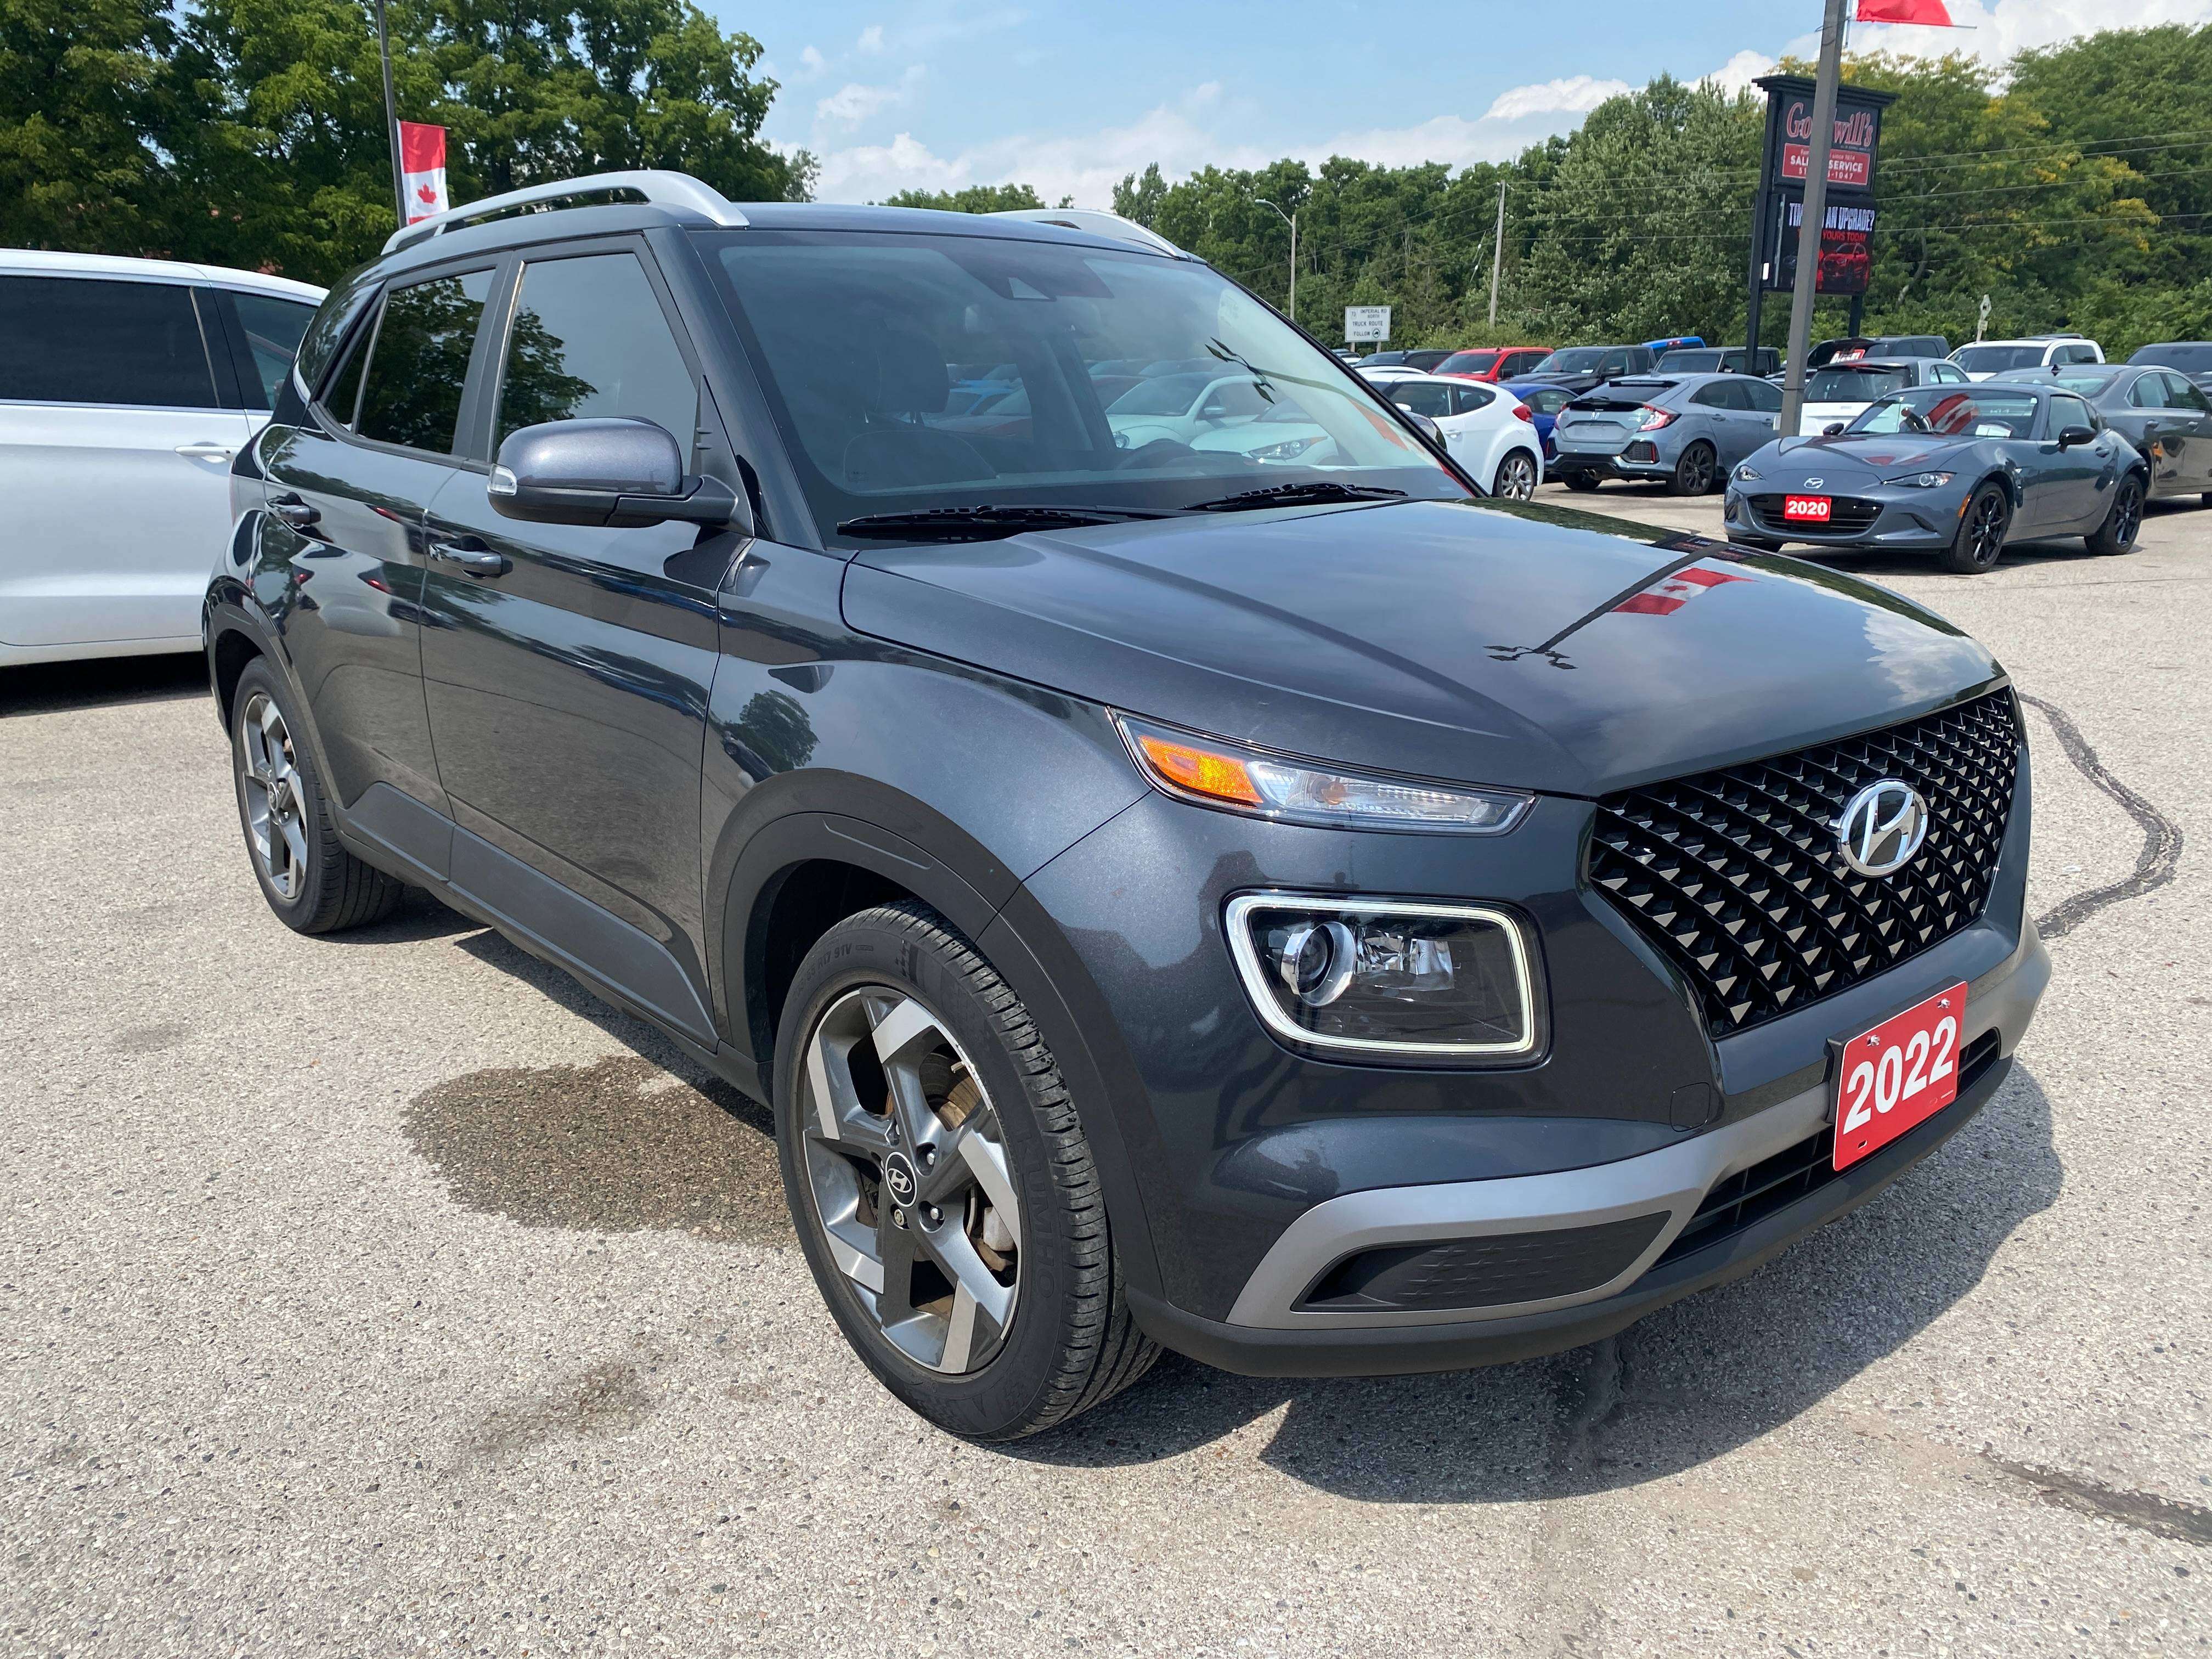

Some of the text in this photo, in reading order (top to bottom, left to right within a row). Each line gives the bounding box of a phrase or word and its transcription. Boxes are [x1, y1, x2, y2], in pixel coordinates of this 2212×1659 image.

[1786, 101, 1874, 146] Gowill's
[1828, 160, 1863, 172] SERVICE
[1825, 206, 1838, 229] AN
[1838, 207, 1875, 232] UPGRADE?
[1847, 232, 1867, 242] TODAY
[1787, 500, 1828, 516] 2020
[1843, 1015, 1957, 1135] 2022
